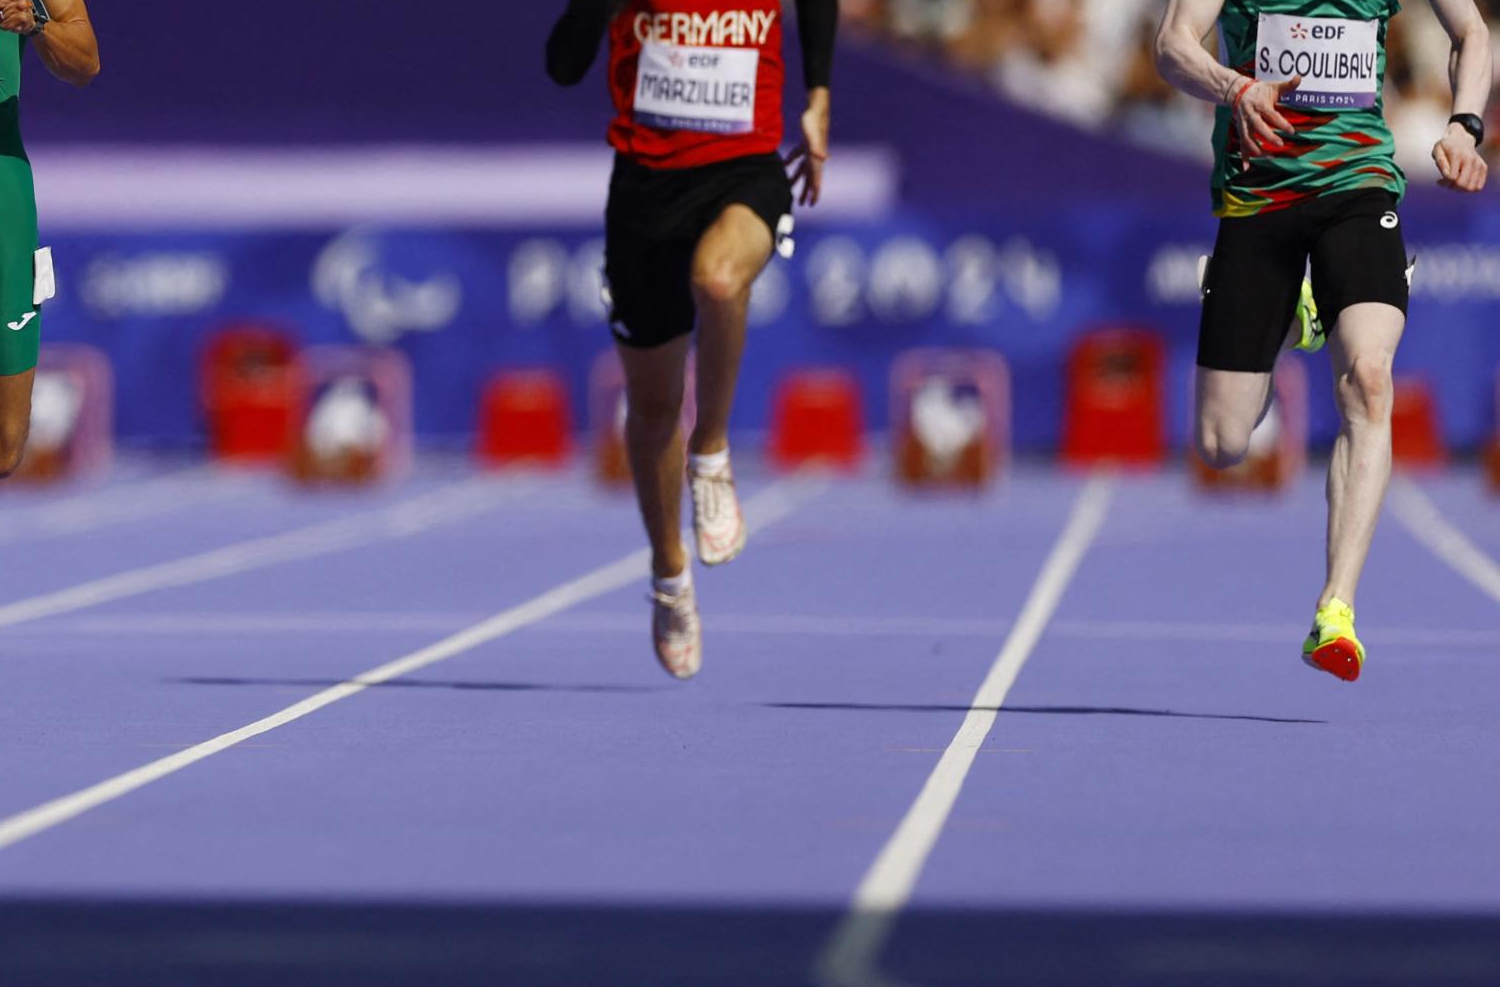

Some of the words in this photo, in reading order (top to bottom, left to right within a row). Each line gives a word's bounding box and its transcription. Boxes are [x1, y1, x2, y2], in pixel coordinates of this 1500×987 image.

[633, 9, 778, 46] GERMANY
[1259, 46, 1274, 74] S.
[1278, 49, 1375, 80] COULIBALY
[640, 72, 751, 107] MARZILLIER
[1295, 93, 1326, 104] PARIS
[1329, 94, 1356, 105] 2024
